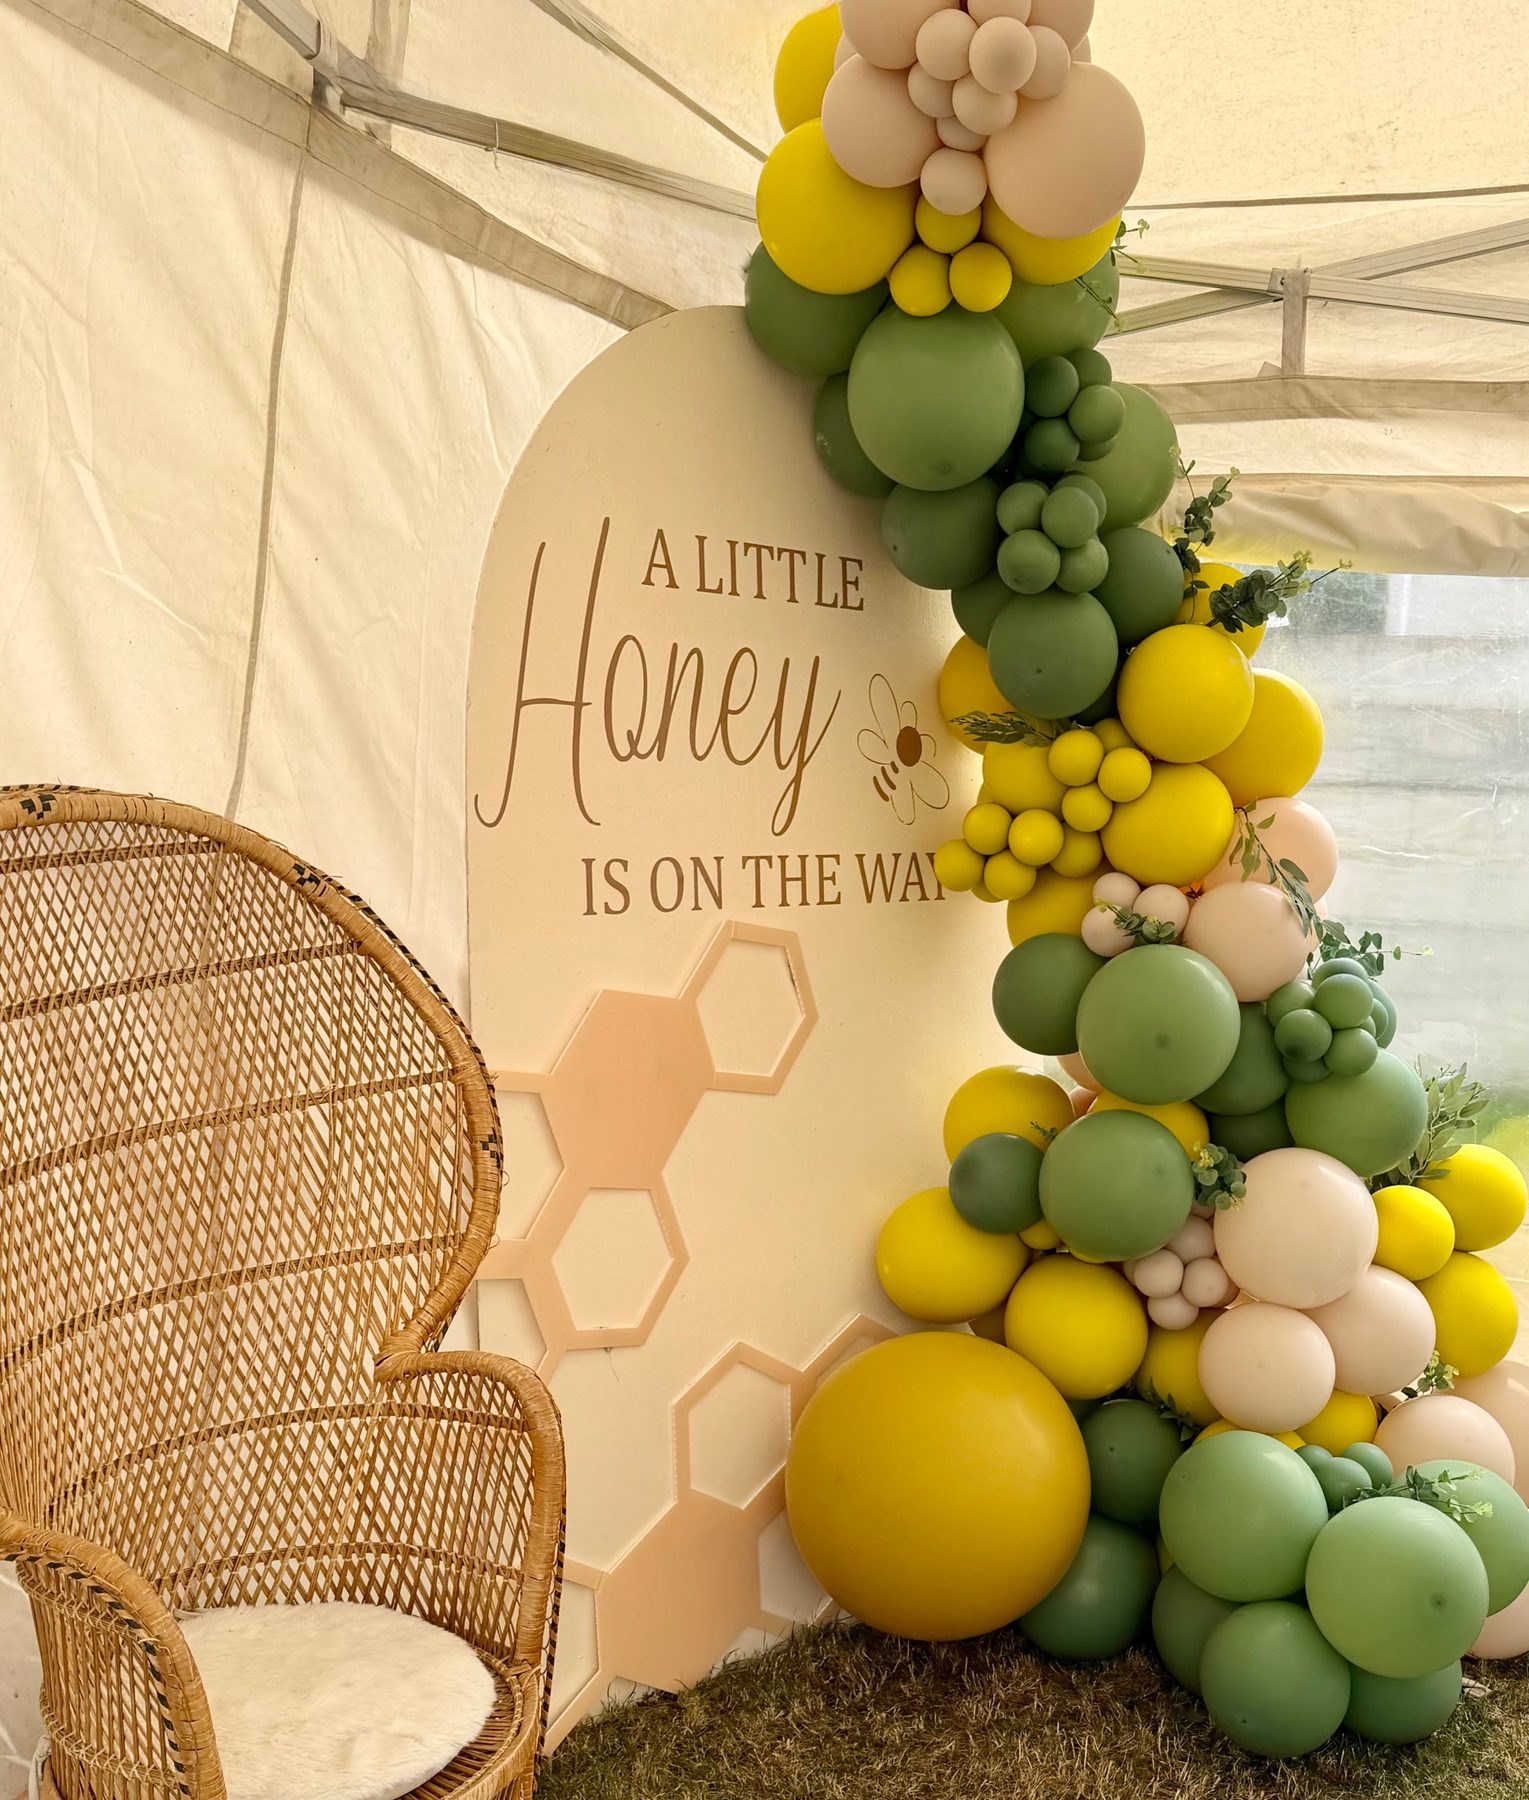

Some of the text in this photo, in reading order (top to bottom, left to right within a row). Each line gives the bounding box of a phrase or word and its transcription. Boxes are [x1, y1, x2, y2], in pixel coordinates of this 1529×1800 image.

[641, 528, 864, 612] A LITTLE
[474, 516, 842, 837] Honey
[581, 857, 631, 916] IS
[649, 856, 725, 913] ON
[741, 853, 842, 909] THE
